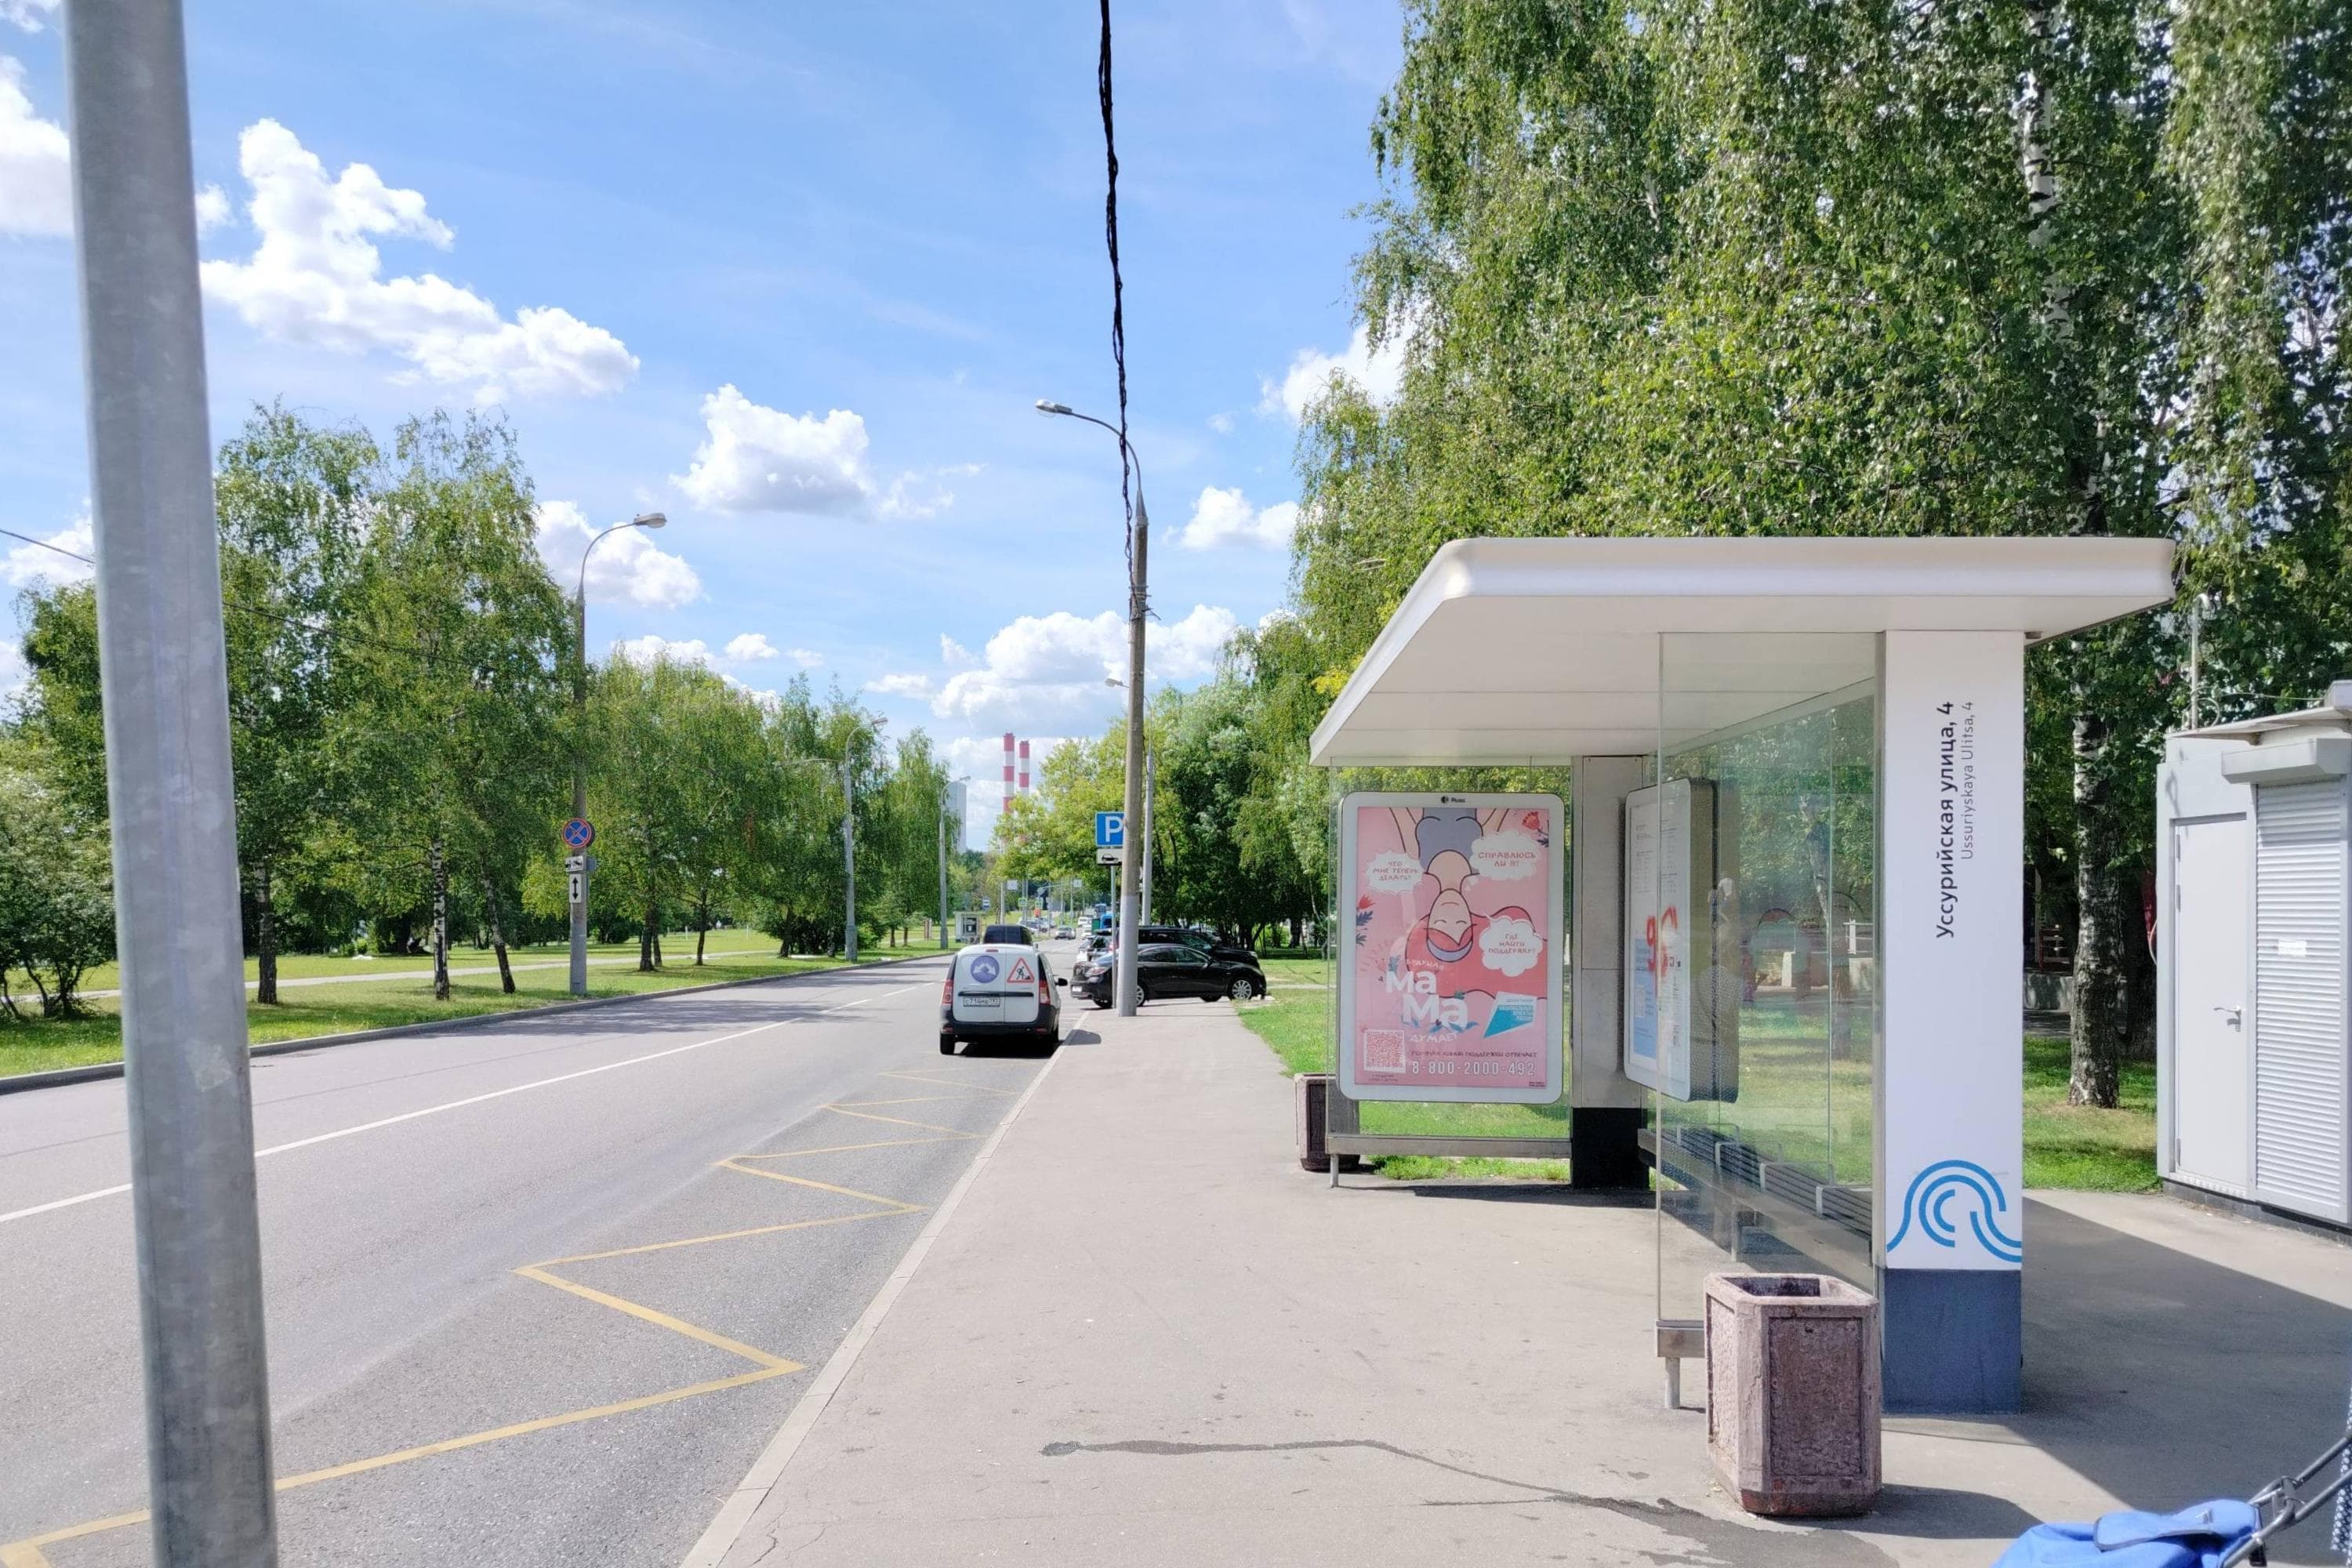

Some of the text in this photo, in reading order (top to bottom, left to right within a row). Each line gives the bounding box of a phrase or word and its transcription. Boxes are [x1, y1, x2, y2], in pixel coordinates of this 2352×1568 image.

[1960, 701, 1976, 860] Ussuriyskaya Ulitsa, 4
[1105, 815, 1124, 843] P
[1936, 701, 1958, 938] Уссурийская улица, 4
[1477, 851, 1537, 860] СПРАВЛЮСЬ
[1412, 1061, 1536, 1076] 8-800-2000-492
